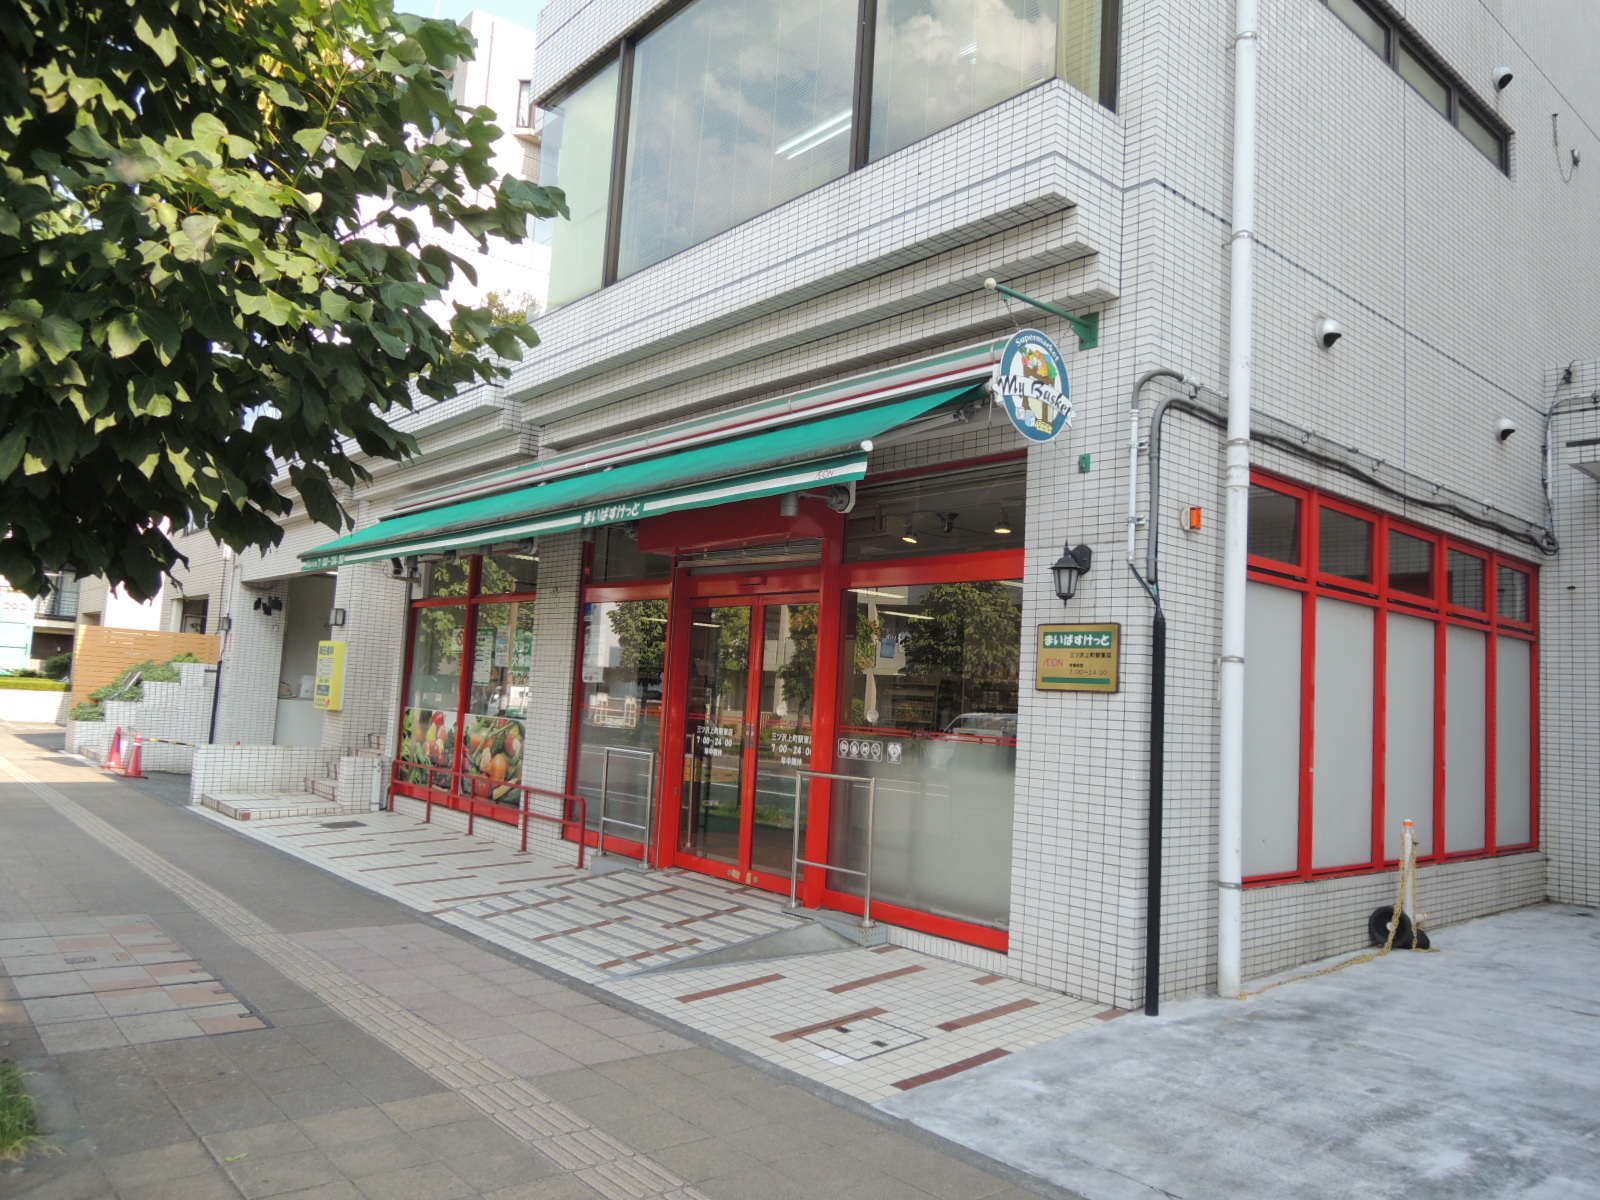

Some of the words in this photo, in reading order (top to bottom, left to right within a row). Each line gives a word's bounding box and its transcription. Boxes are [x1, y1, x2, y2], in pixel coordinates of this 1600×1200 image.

[1015, 334, 1060, 362] Supermarket
[997, 374, 1025, 399] My
[1031, 379, 1072, 417] Basket
[583, 502, 640, 525] まいばすけっと
[1044, 634, 1110, 646] まいばすけっと
[696, 725, 734, 737] 三ツ沢上町駅東店
